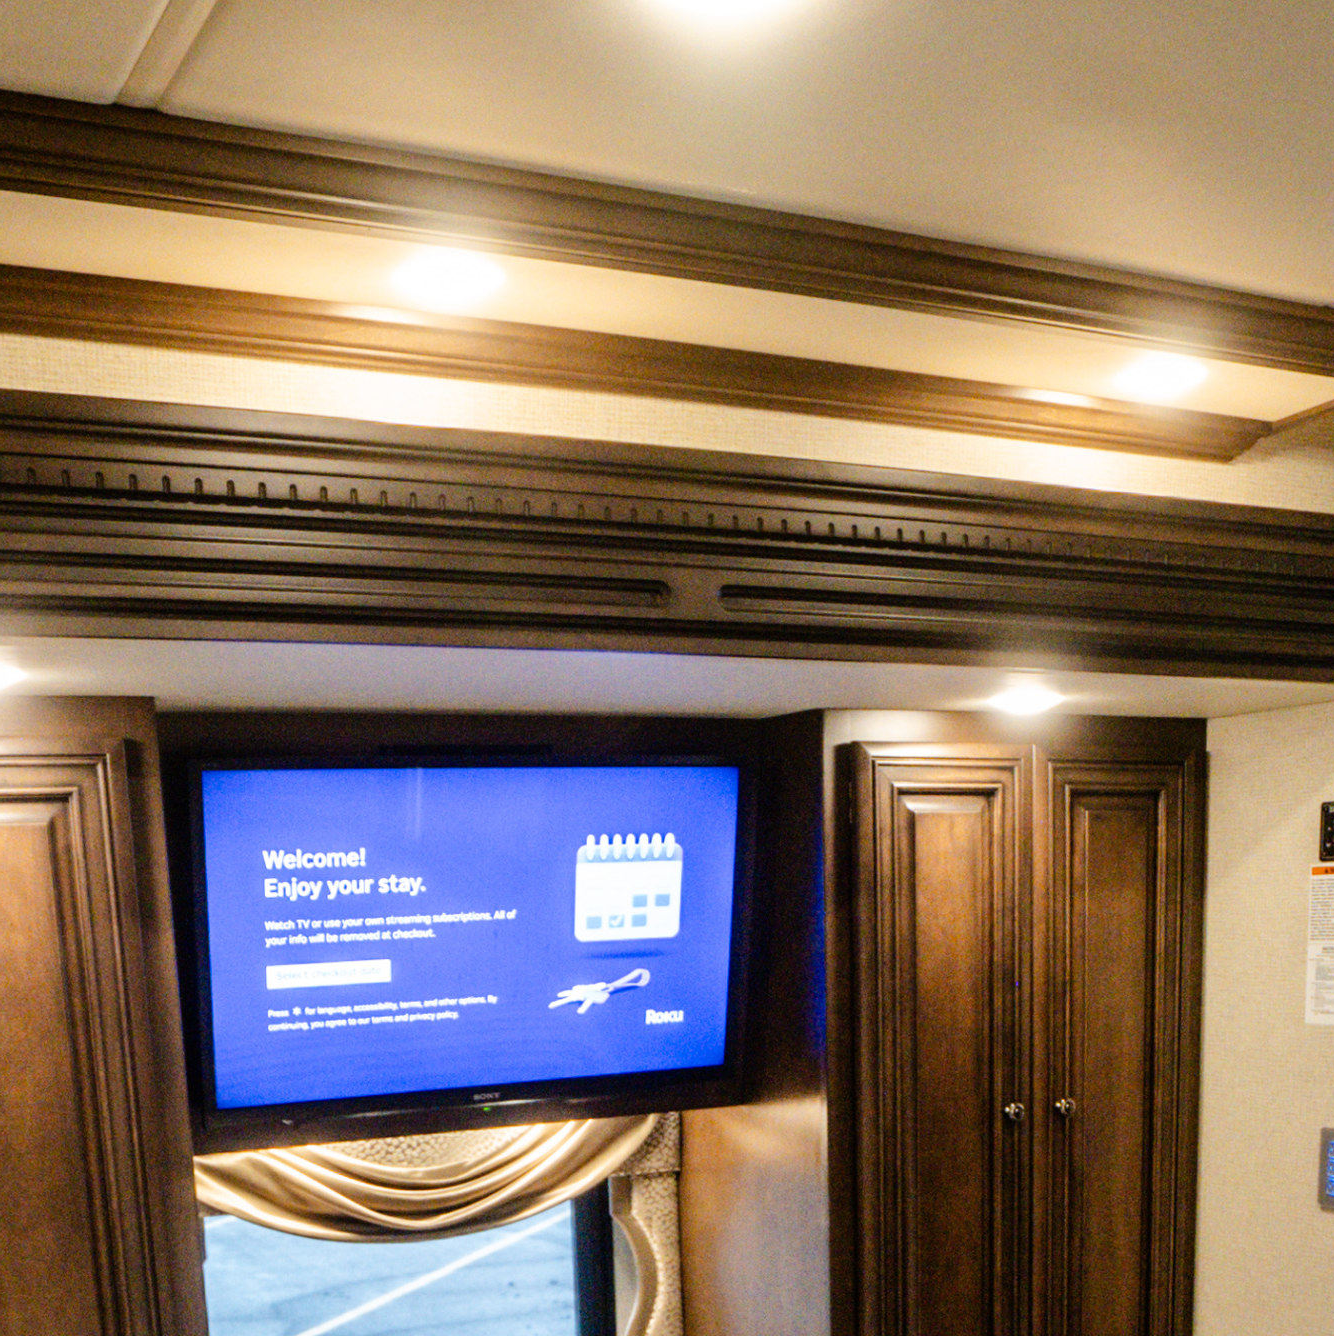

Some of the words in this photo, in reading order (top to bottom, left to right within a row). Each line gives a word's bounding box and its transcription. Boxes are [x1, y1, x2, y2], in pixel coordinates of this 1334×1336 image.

[262, 848, 366, 870] Welcome!
[264, 877, 323, 901] Enjoy
[327, 878, 374, 900] your
[378, 874, 426, 896] stay.
[264, 918, 295, 931] Watch
[296, 918, 311, 930] TV
[311, 919, 322, 928] or
[323, 918, 341, 928] use
[342, 917, 364, 930] your
[365, 916, 385, 926] own
[386, 914, 431, 926] streaming
[493, 909, 506, 920] All
[506, 908, 517, 920] of
[265, 936, 287, 949] your
[288, 934, 308, 945] info
[309, 933, 325, 944] will
[326, 932, 339, 943] be
[339, 930, 380, 942] removed
[381, 930, 392, 940] at
[392, 928, 436, 940] checkout.
[304, 1006, 316, 1015] for
[423, 998, 438, 1007] and
[310, 1020, 325, 1029] you
[347, 1018, 357, 1026] to
[357, 1017, 370, 1025] our
[394, 1013, 409, 1022] and
